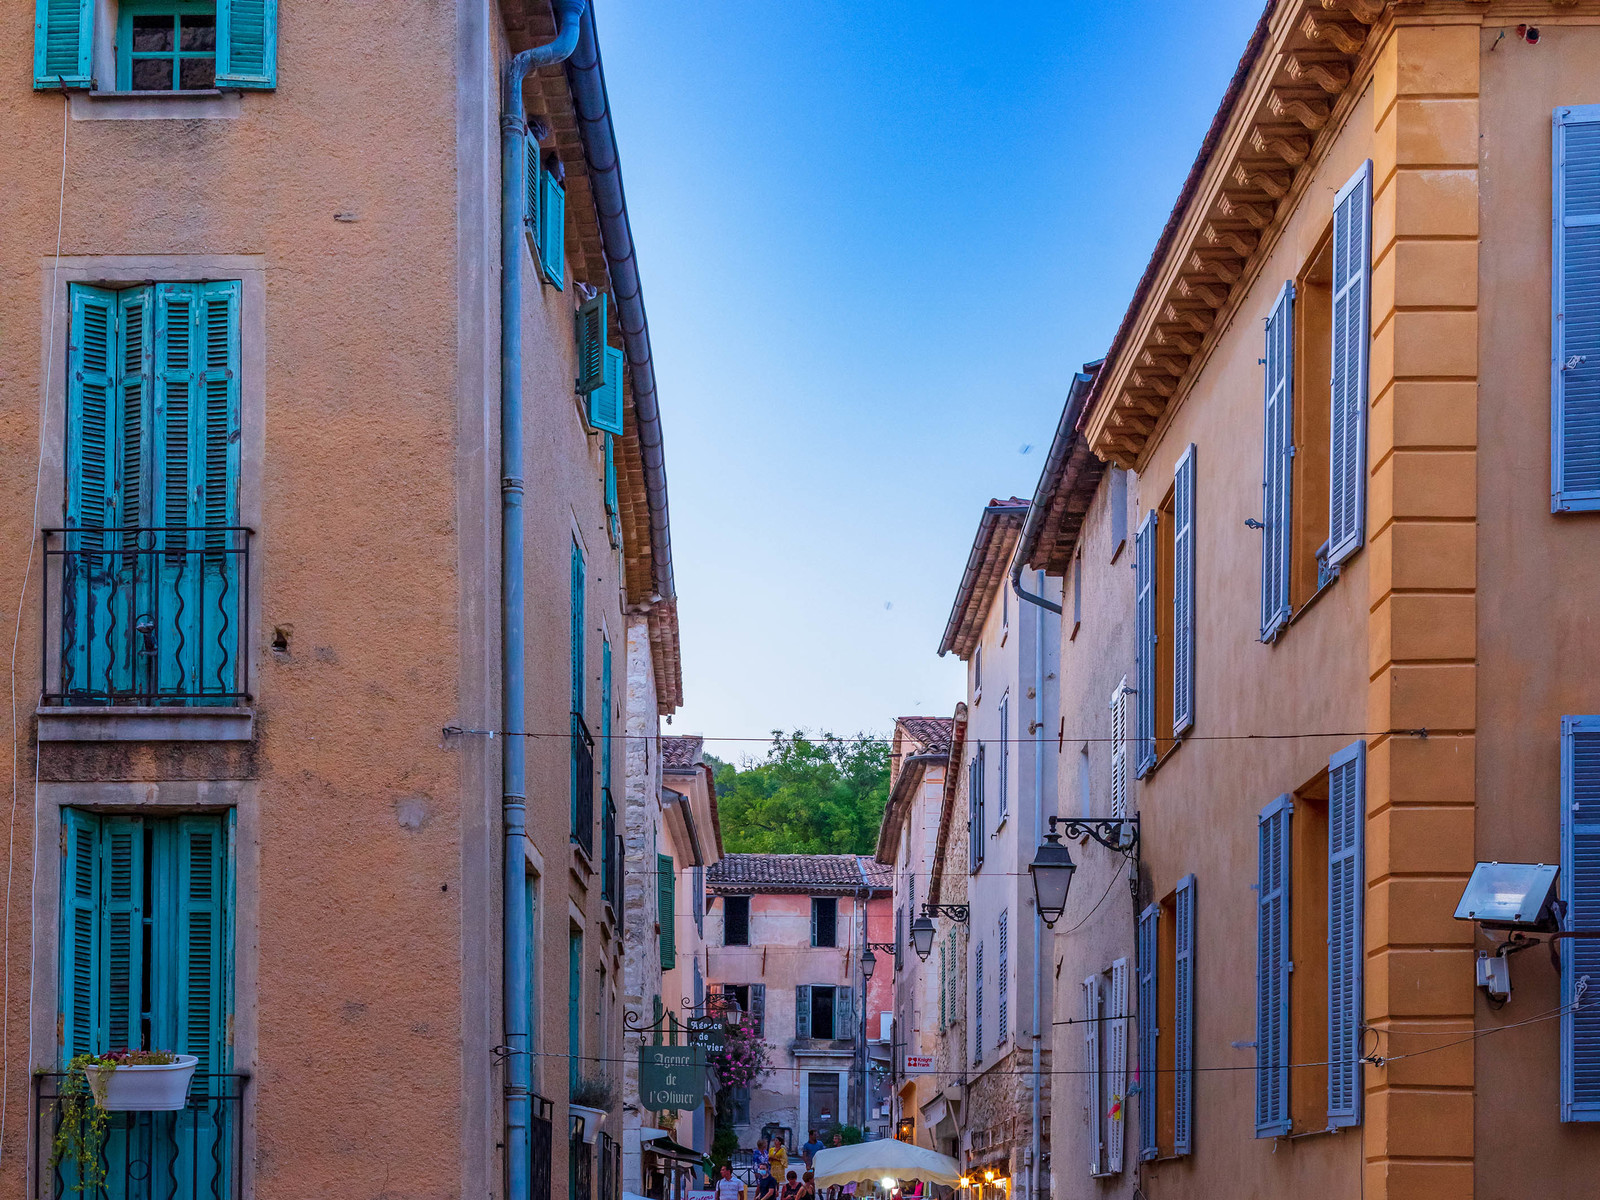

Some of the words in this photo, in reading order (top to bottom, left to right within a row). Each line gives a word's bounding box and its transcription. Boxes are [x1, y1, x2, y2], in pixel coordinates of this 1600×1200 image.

[699, 1032, 709, 1041] de
[654, 1053, 690, 1069] Agence
[666, 1073, 677, 1086] de
[649, 1090, 694, 1104] l'Olivier
